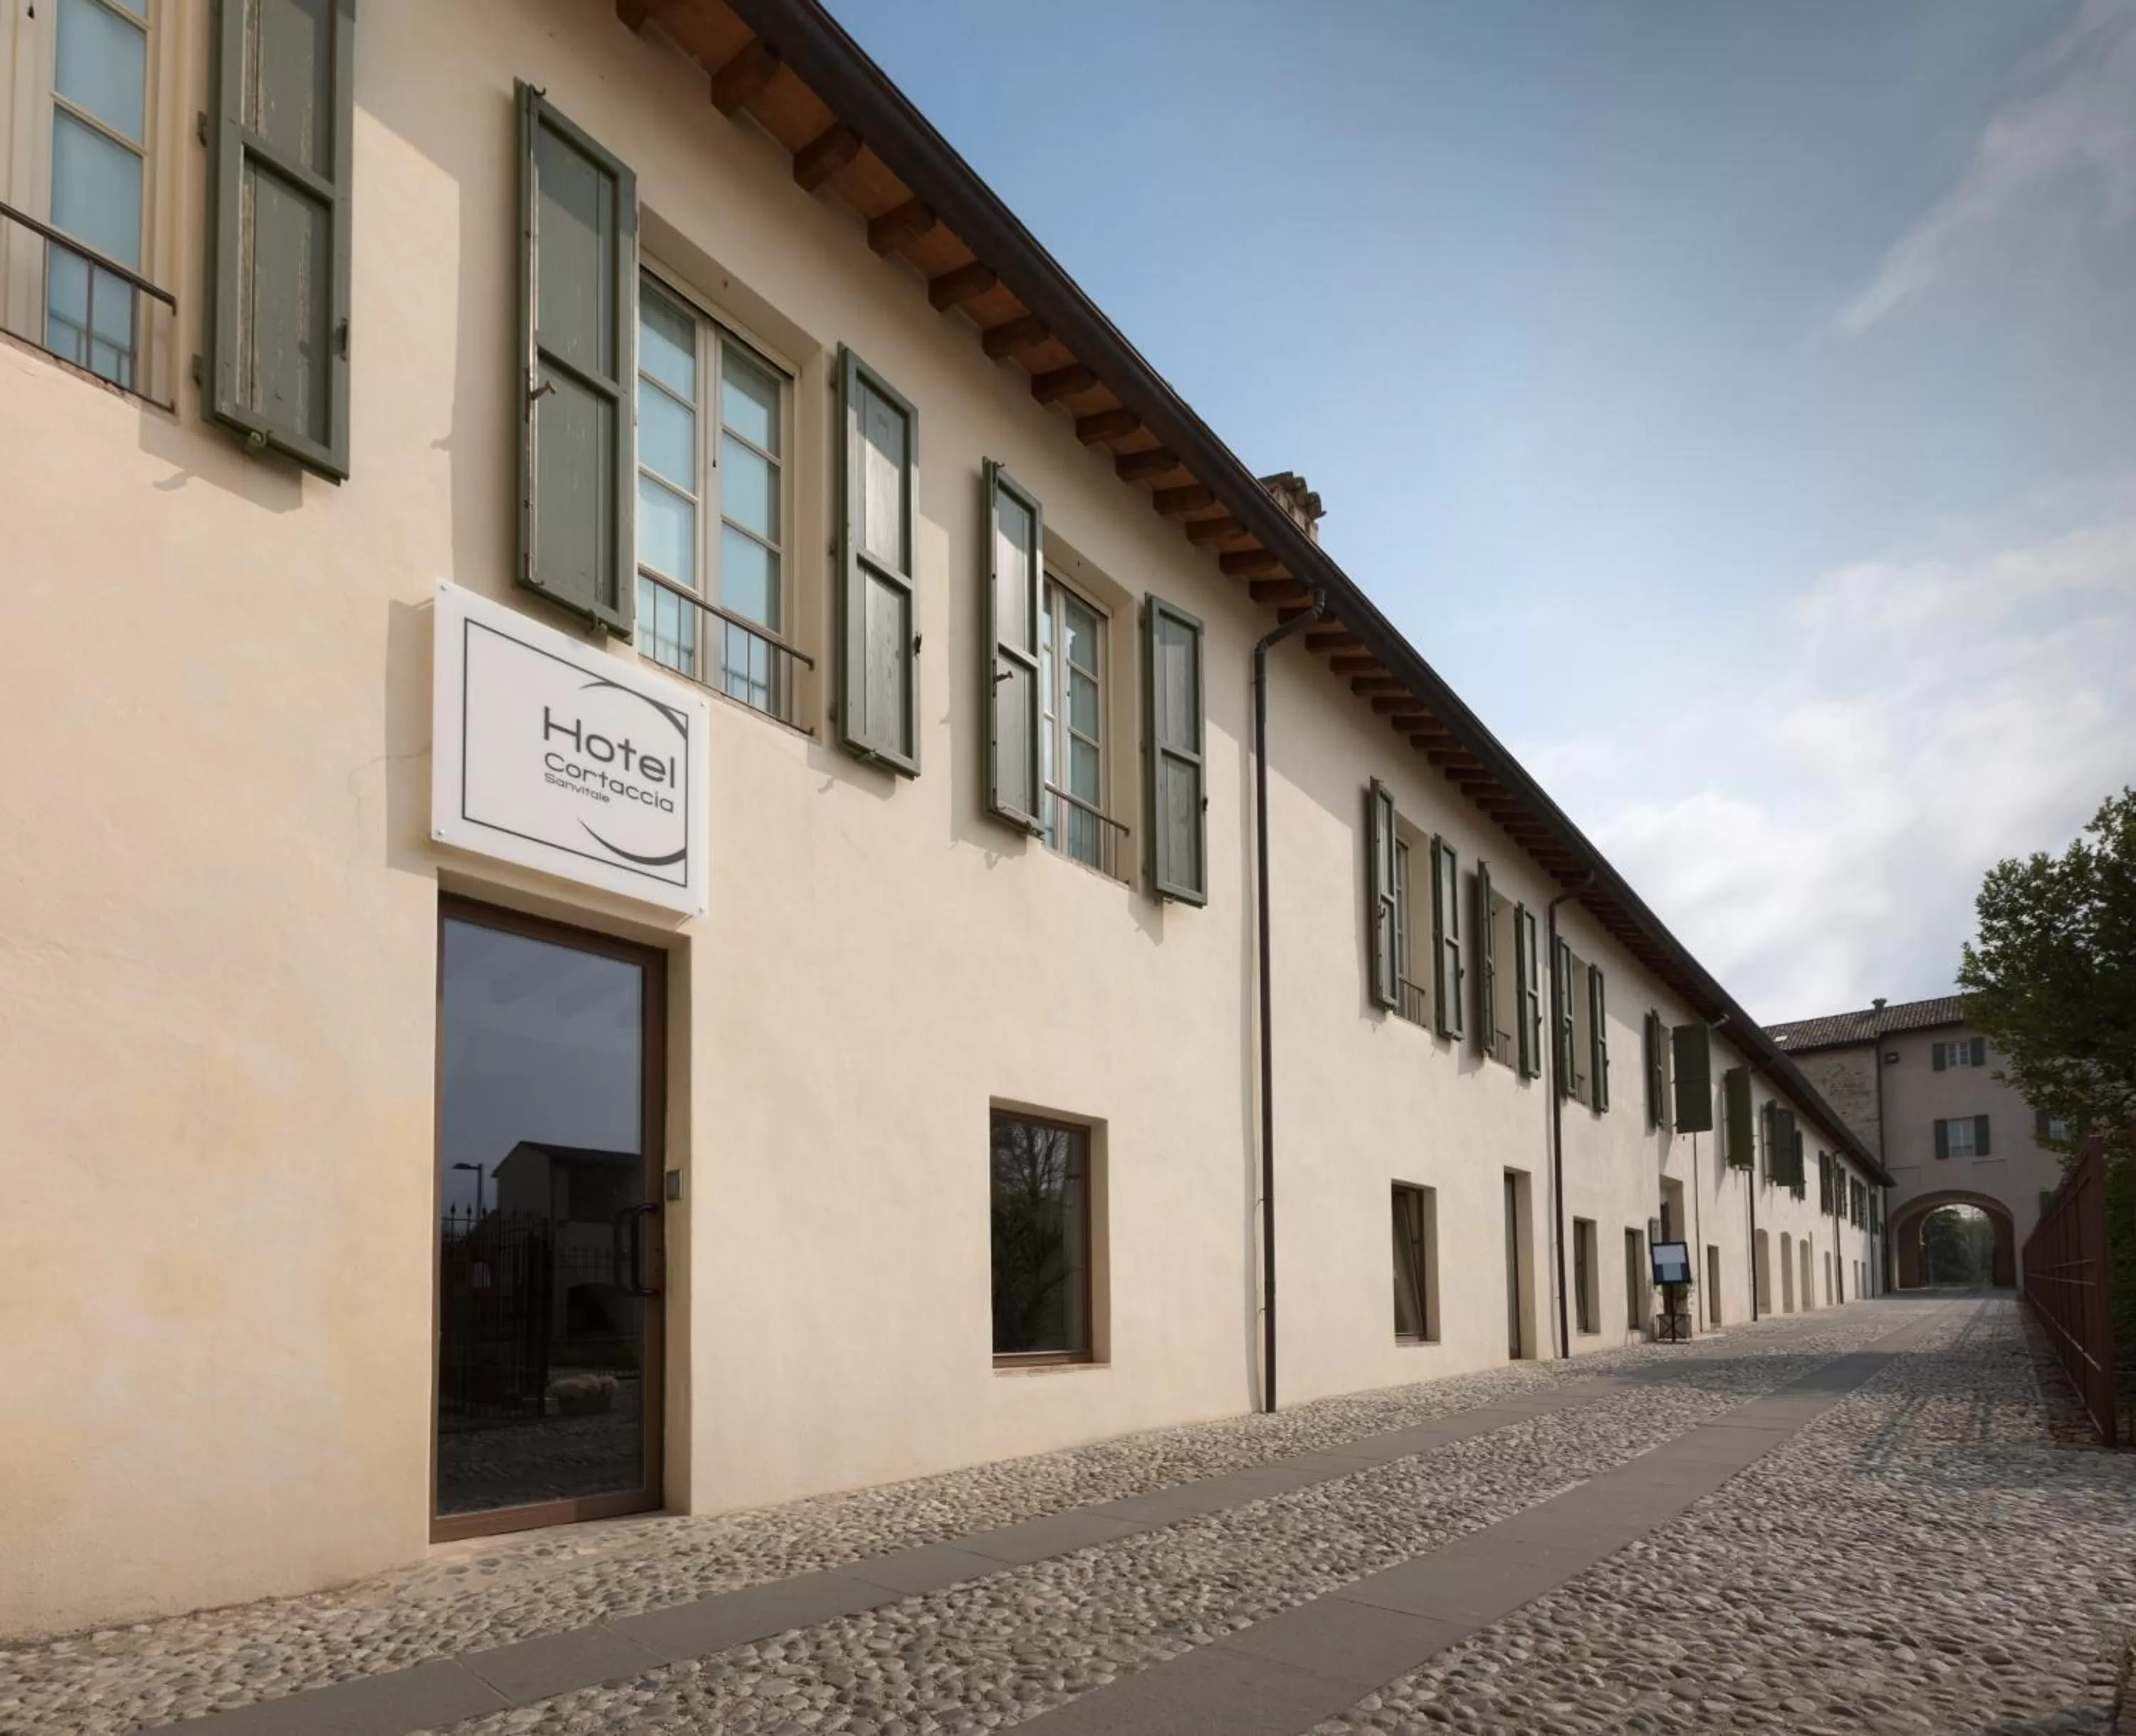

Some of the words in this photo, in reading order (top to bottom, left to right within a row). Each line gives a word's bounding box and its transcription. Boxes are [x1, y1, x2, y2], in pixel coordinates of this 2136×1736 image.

[543, 706, 675, 789] Hotel
[544, 752, 674, 813] Cortaccia
[544, 772, 611, 803] Sanvitale
